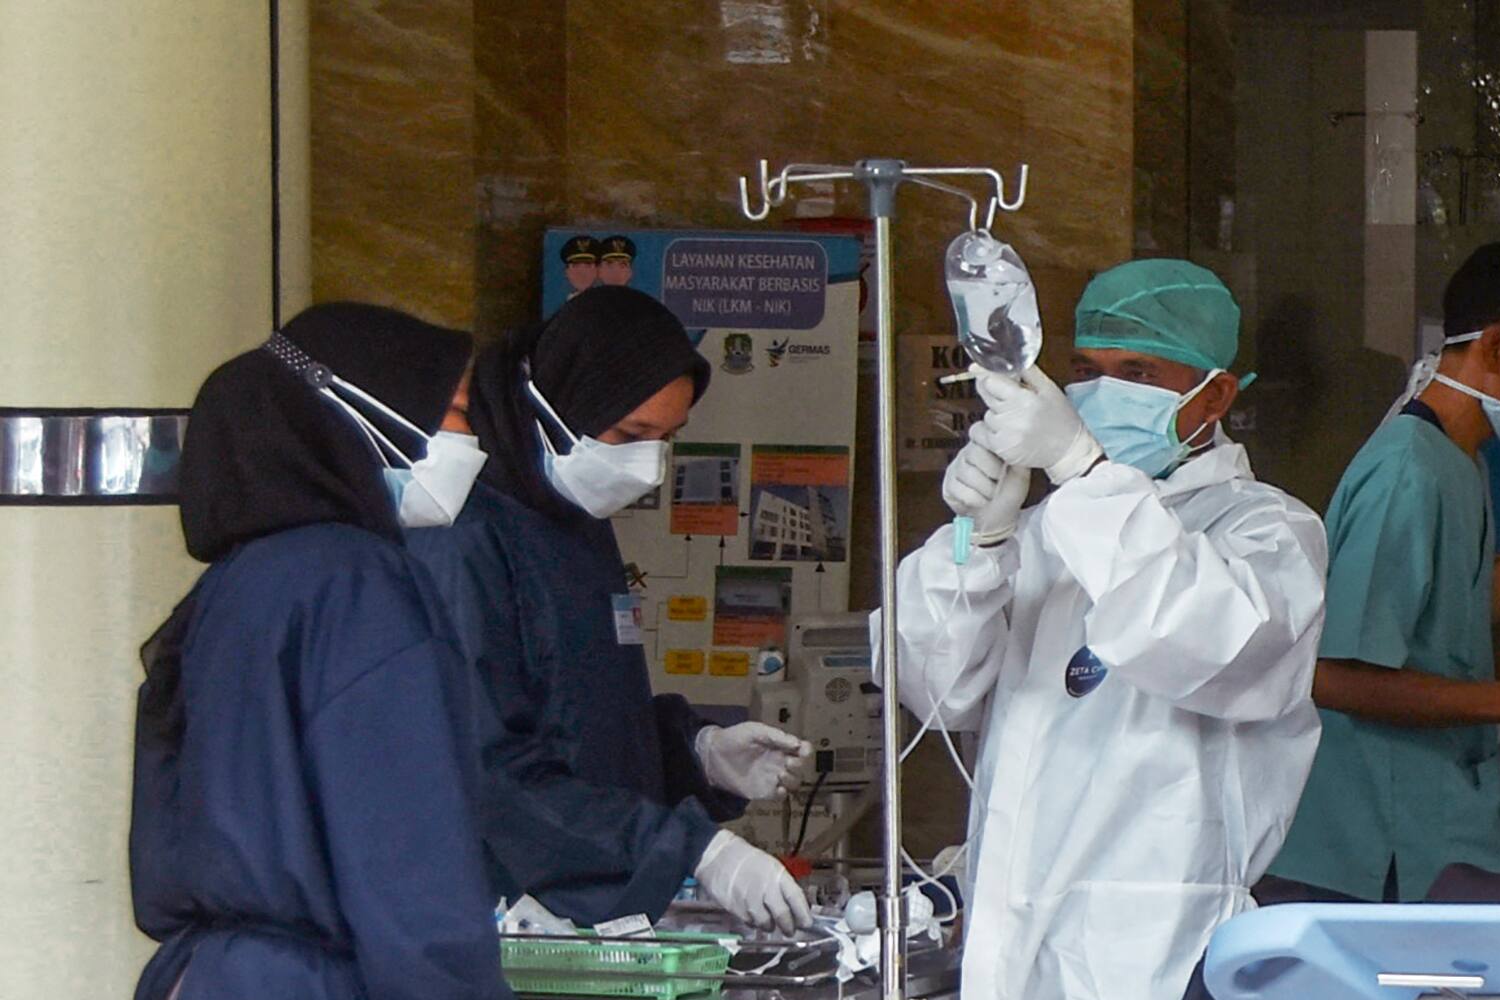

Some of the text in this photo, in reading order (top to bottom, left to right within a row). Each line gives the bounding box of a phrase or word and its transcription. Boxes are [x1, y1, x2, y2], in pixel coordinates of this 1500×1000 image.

[672, 253, 815, 270] LAYANAN KESEHATAN
[665, 275, 820, 293] MASYARAKAT BERBASIS
[691, 299, 716, 313] NIK
[718, 299, 752, 315] (LKM
[763, 300, 792, 316] NIK)
[788, 345, 831, 355] GERMAS
[1069, 666, 1089, 676] ZETA
